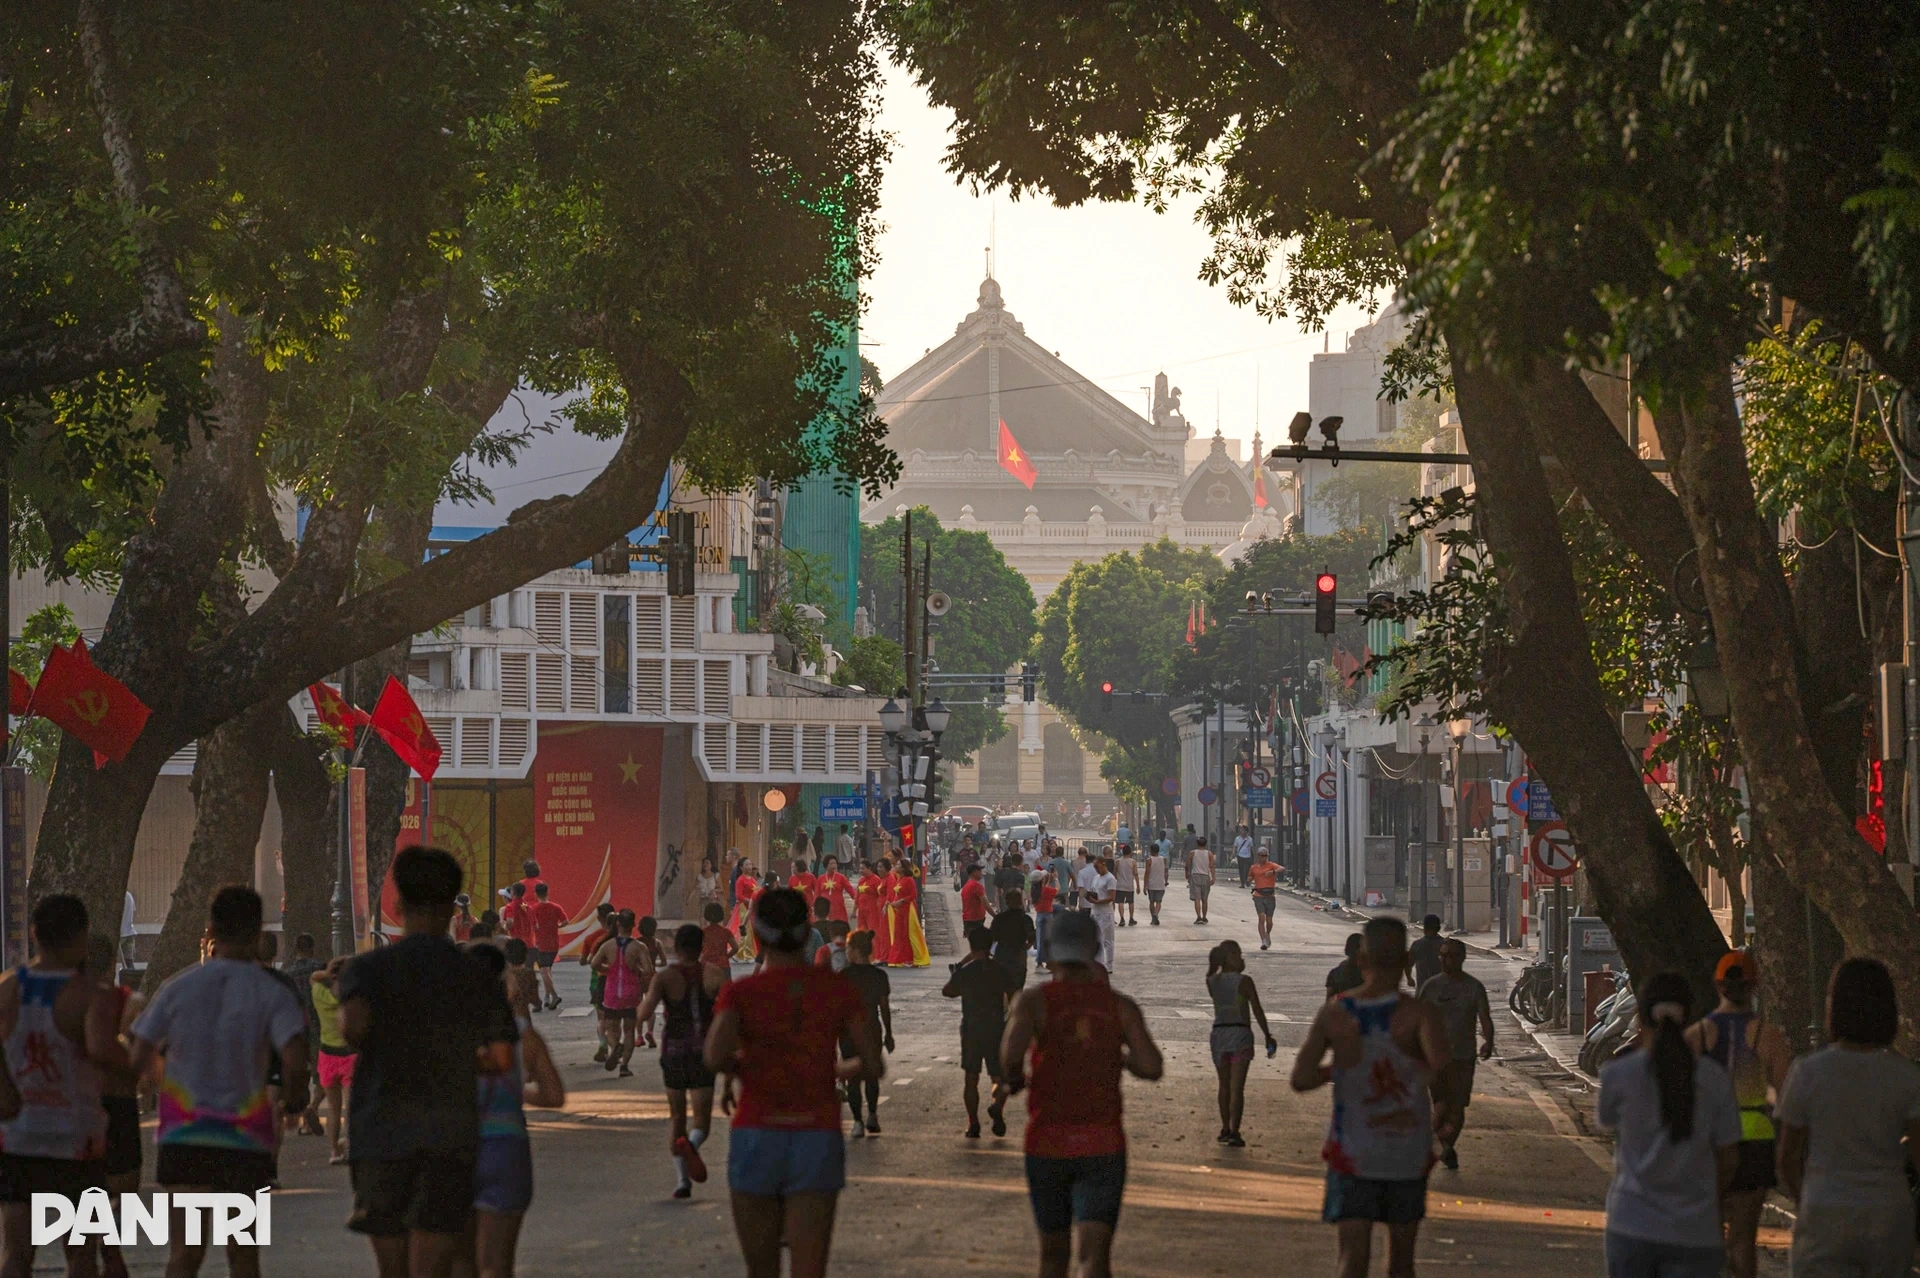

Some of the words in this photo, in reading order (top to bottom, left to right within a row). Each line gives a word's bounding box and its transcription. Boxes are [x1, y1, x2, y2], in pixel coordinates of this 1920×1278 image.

[552, 783, 568, 796] QUỐC
[568, 783, 588, 796] KHÁNH
[847, 806, 863, 817] HOÀNG
[556, 825, 568, 837] VIỆT
[569, 826, 584, 836] NAM
